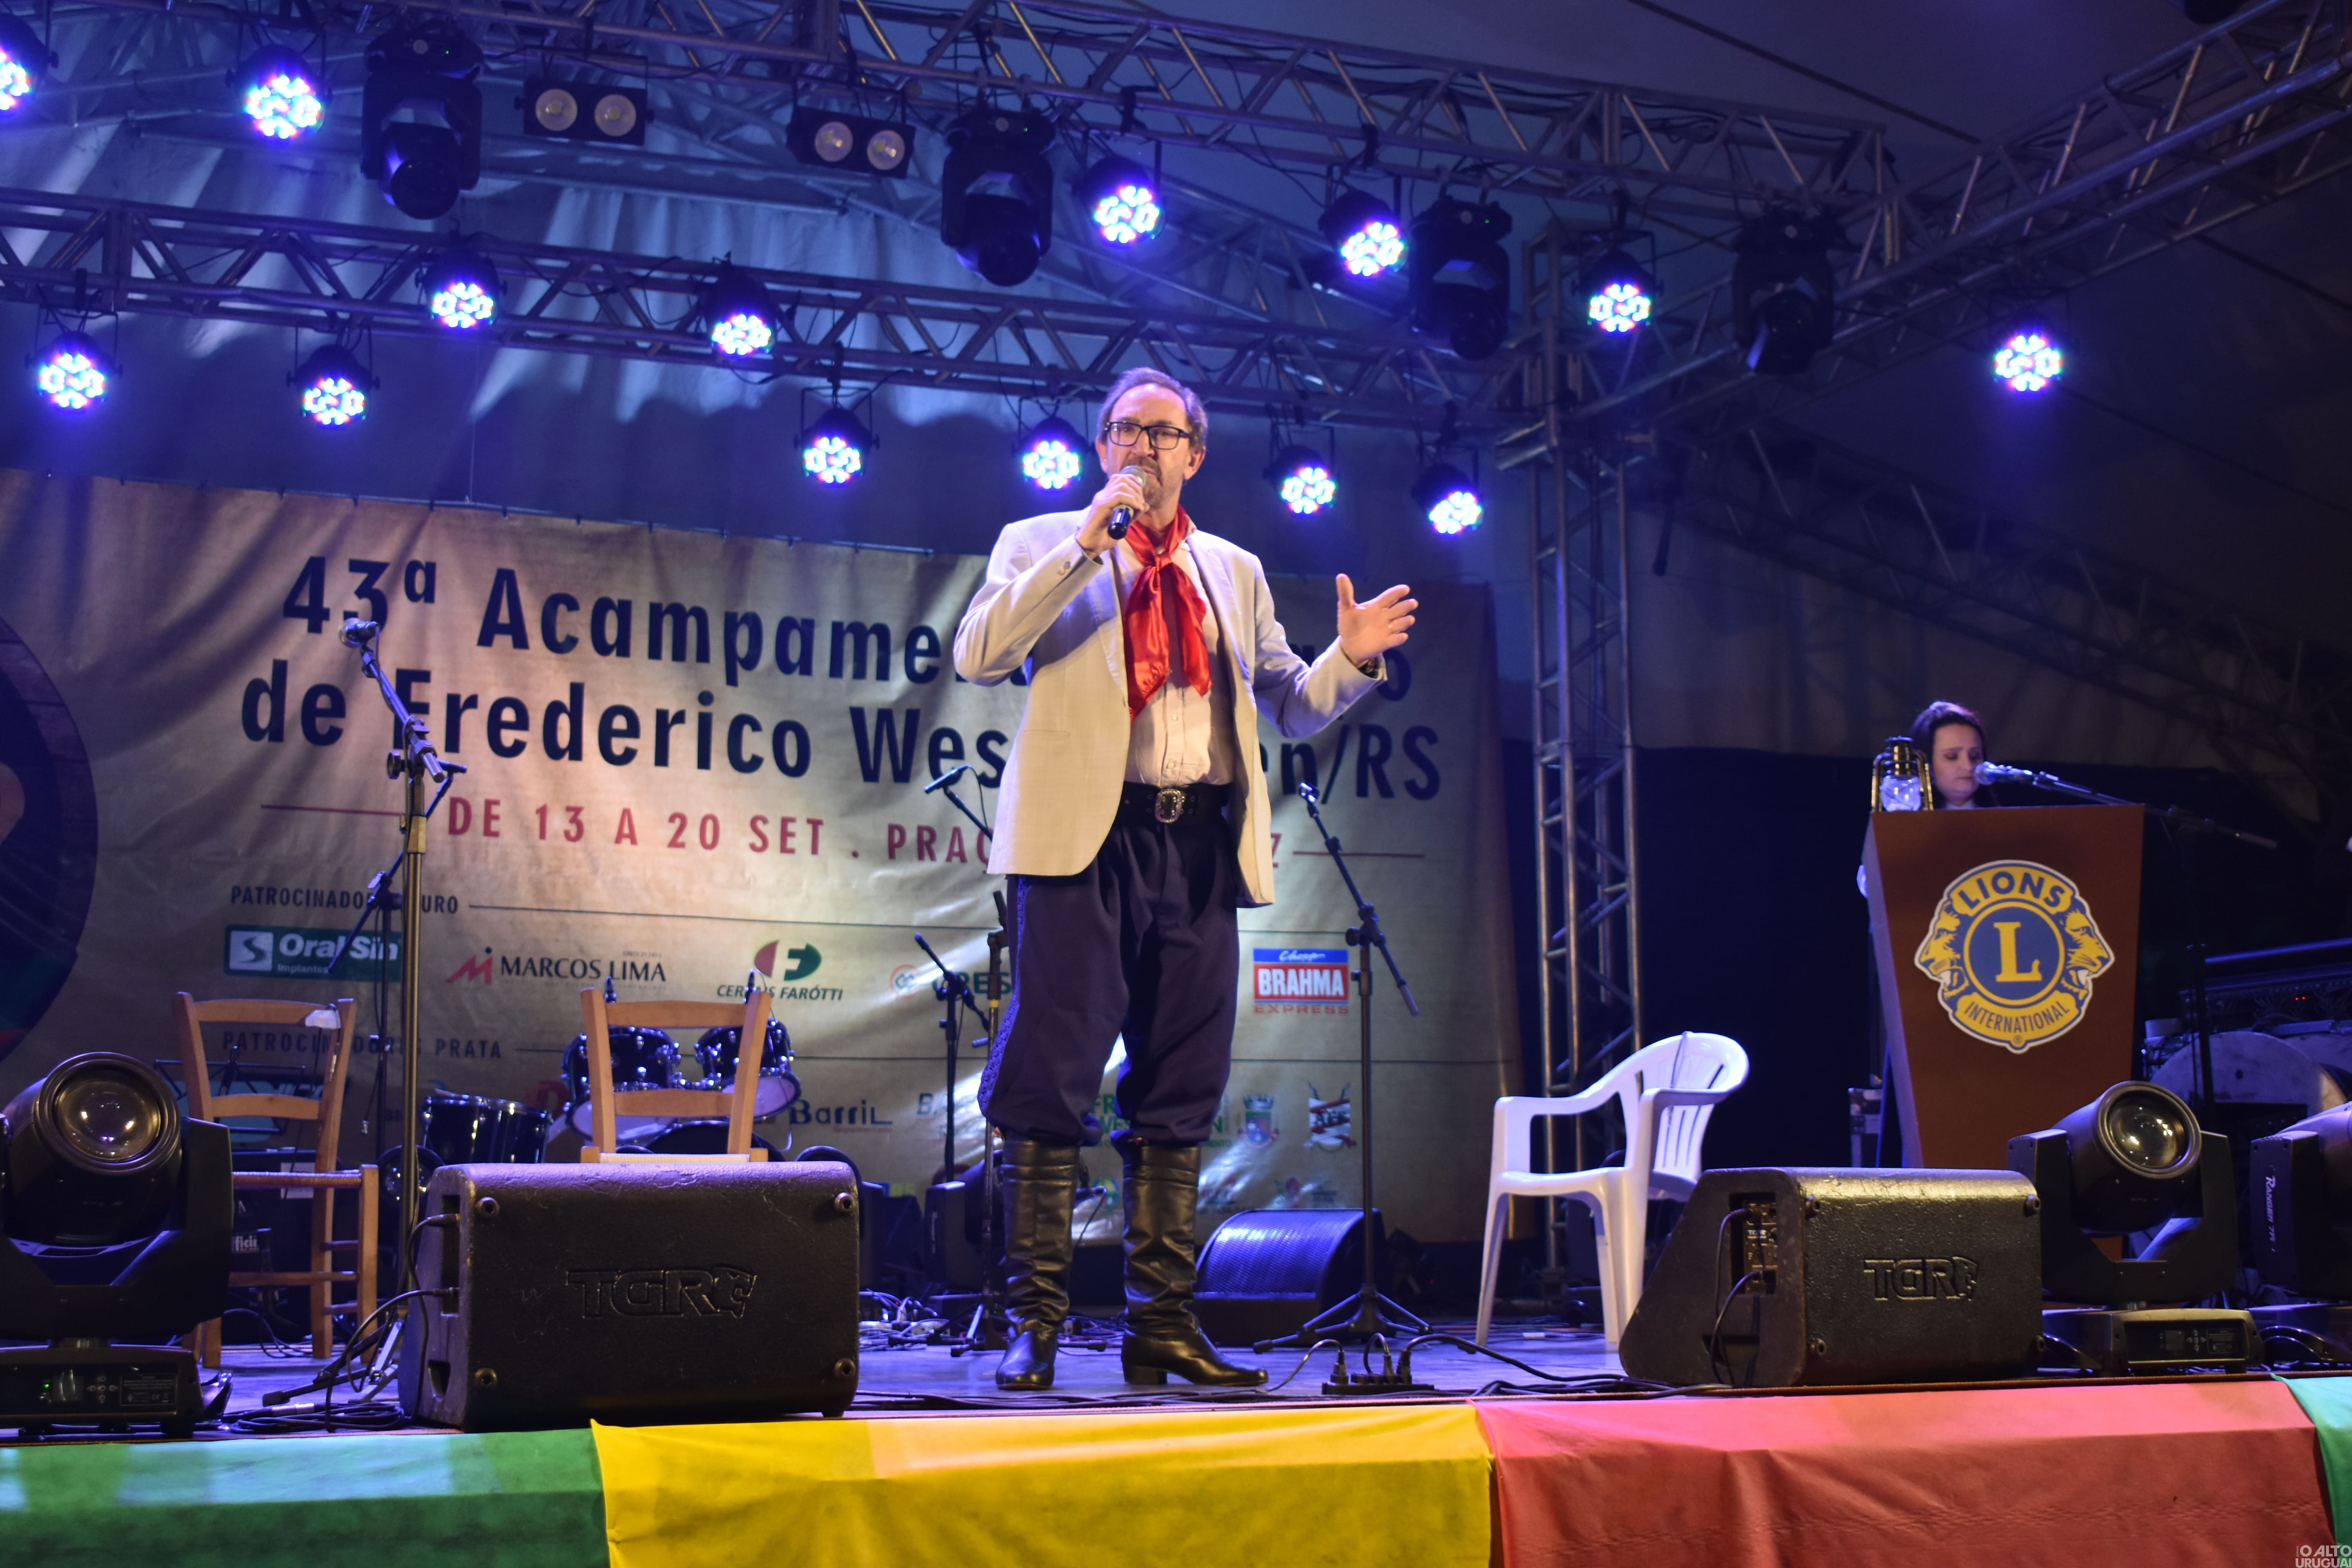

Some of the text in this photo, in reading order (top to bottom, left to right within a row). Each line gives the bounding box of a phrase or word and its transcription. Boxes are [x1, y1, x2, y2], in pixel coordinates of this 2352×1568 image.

[477, 568, 1028, 687] Acampame
[241, 659, 347, 746] de
[392, 668, 811, 778] Frederico
[448, 797, 501, 838] DE
[535, 804, 584, 842] 13
[614, 808, 638, 845] A
[667, 812, 720, 850] 20
[749, 816, 824, 856] SET
[421, 895, 458, 914] URO
[1958, 871, 2066, 910] LIONS
[279, 933, 347, 958] Oral
[349, 935, 399, 960] Sin
[1993, 922, 2042, 982] L
[501, 956, 666, 982] MARCOS LIMA
[1258, 968, 1345, 996] BRAHMA
[780, 984, 843, 1000] FARÓTTI
[1255, 1004, 1349, 1014] EXPRESS
[1964, 1000, 2070, 1034] INTERNATIONAL
[435, 1038, 502, 1059] PRATA
